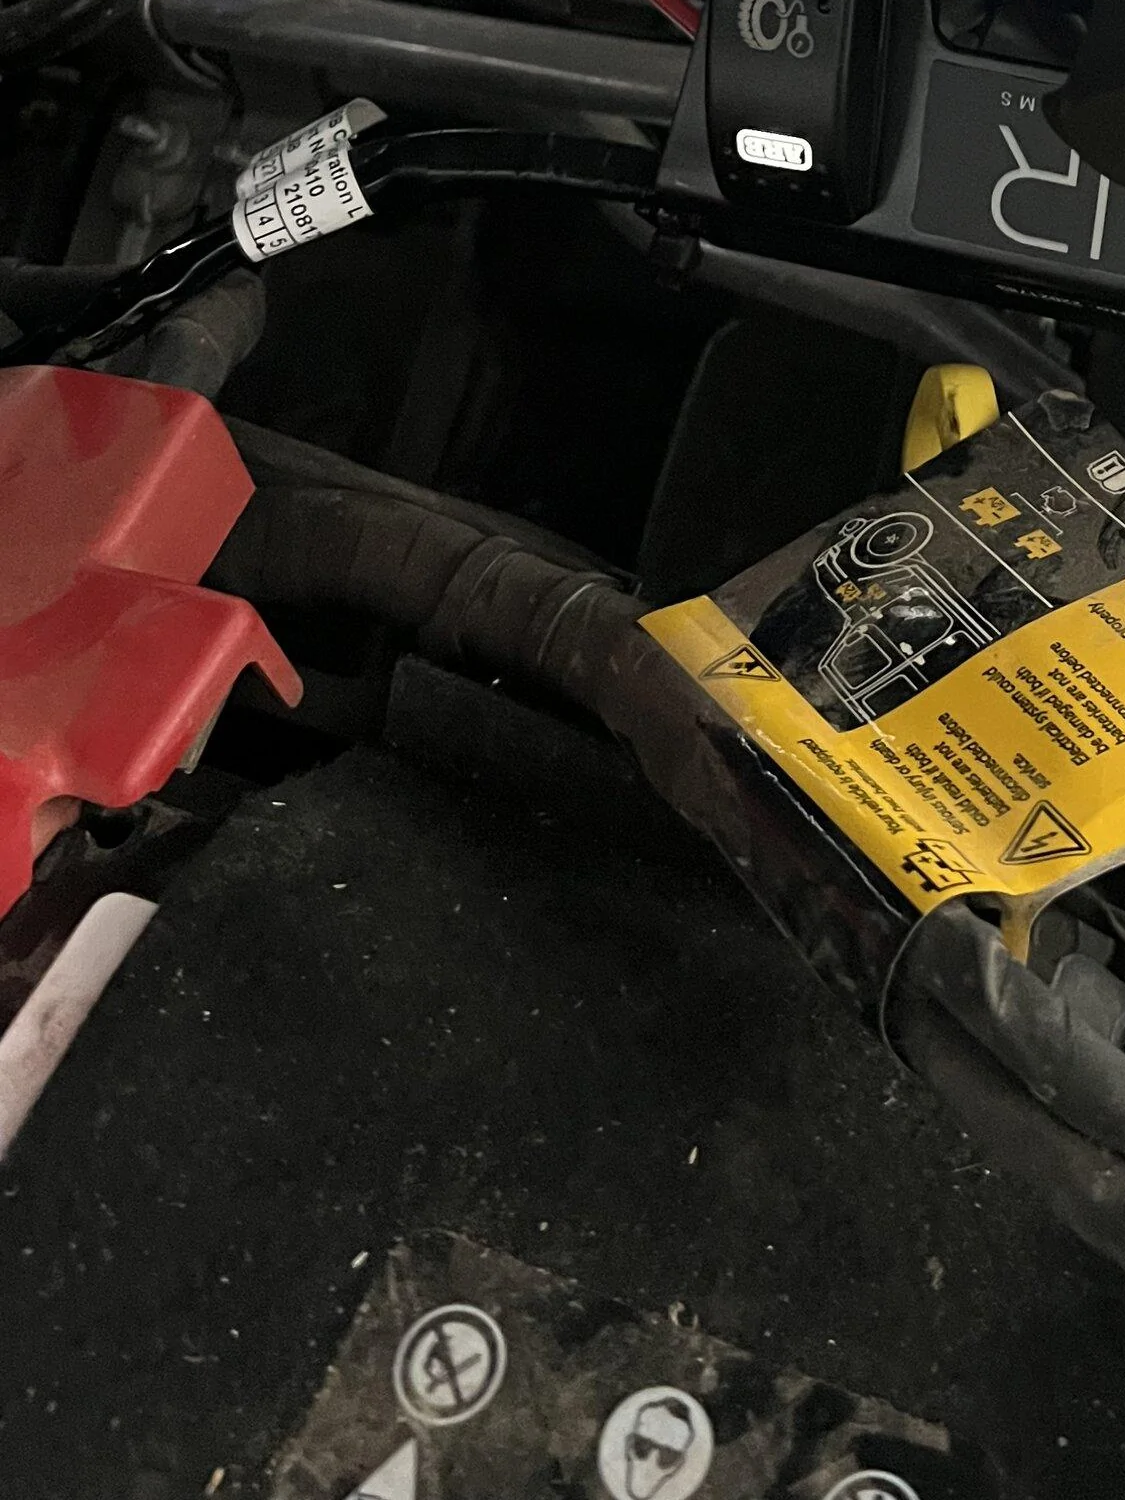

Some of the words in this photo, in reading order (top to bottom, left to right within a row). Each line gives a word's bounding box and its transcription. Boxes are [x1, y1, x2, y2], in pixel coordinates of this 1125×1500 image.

[1048, 640, 1086, 674] before
[980, 665, 1016, 694] could
[1014, 665, 1044, 693] both
[1045, 666, 1072, 687] not
[1009, 689, 1049, 725] system
[1064, 683, 1088, 702] are
[936, 711, 973, 747] before
[1040, 693, 1095, 739] damaged
[795, 737, 846, 776] equipped
[868, 737, 901, 765] death
[903, 741, 933, 770] both
[931, 739, 958, 761] not
[1037, 720, 1090, 767] Electrical
[949, 756, 972, 776] are
[960, 740, 1031, 802] disconnected
[846, 782, 884, 814] vehicle
[903, 773, 938, 802] injury
[930, 770, 966, 801] result
[964, 771, 1012, 818] batteries
[875, 812, 905, 836] Your
[929, 799, 971, 836] Serious
[953, 796, 991, 828] could
